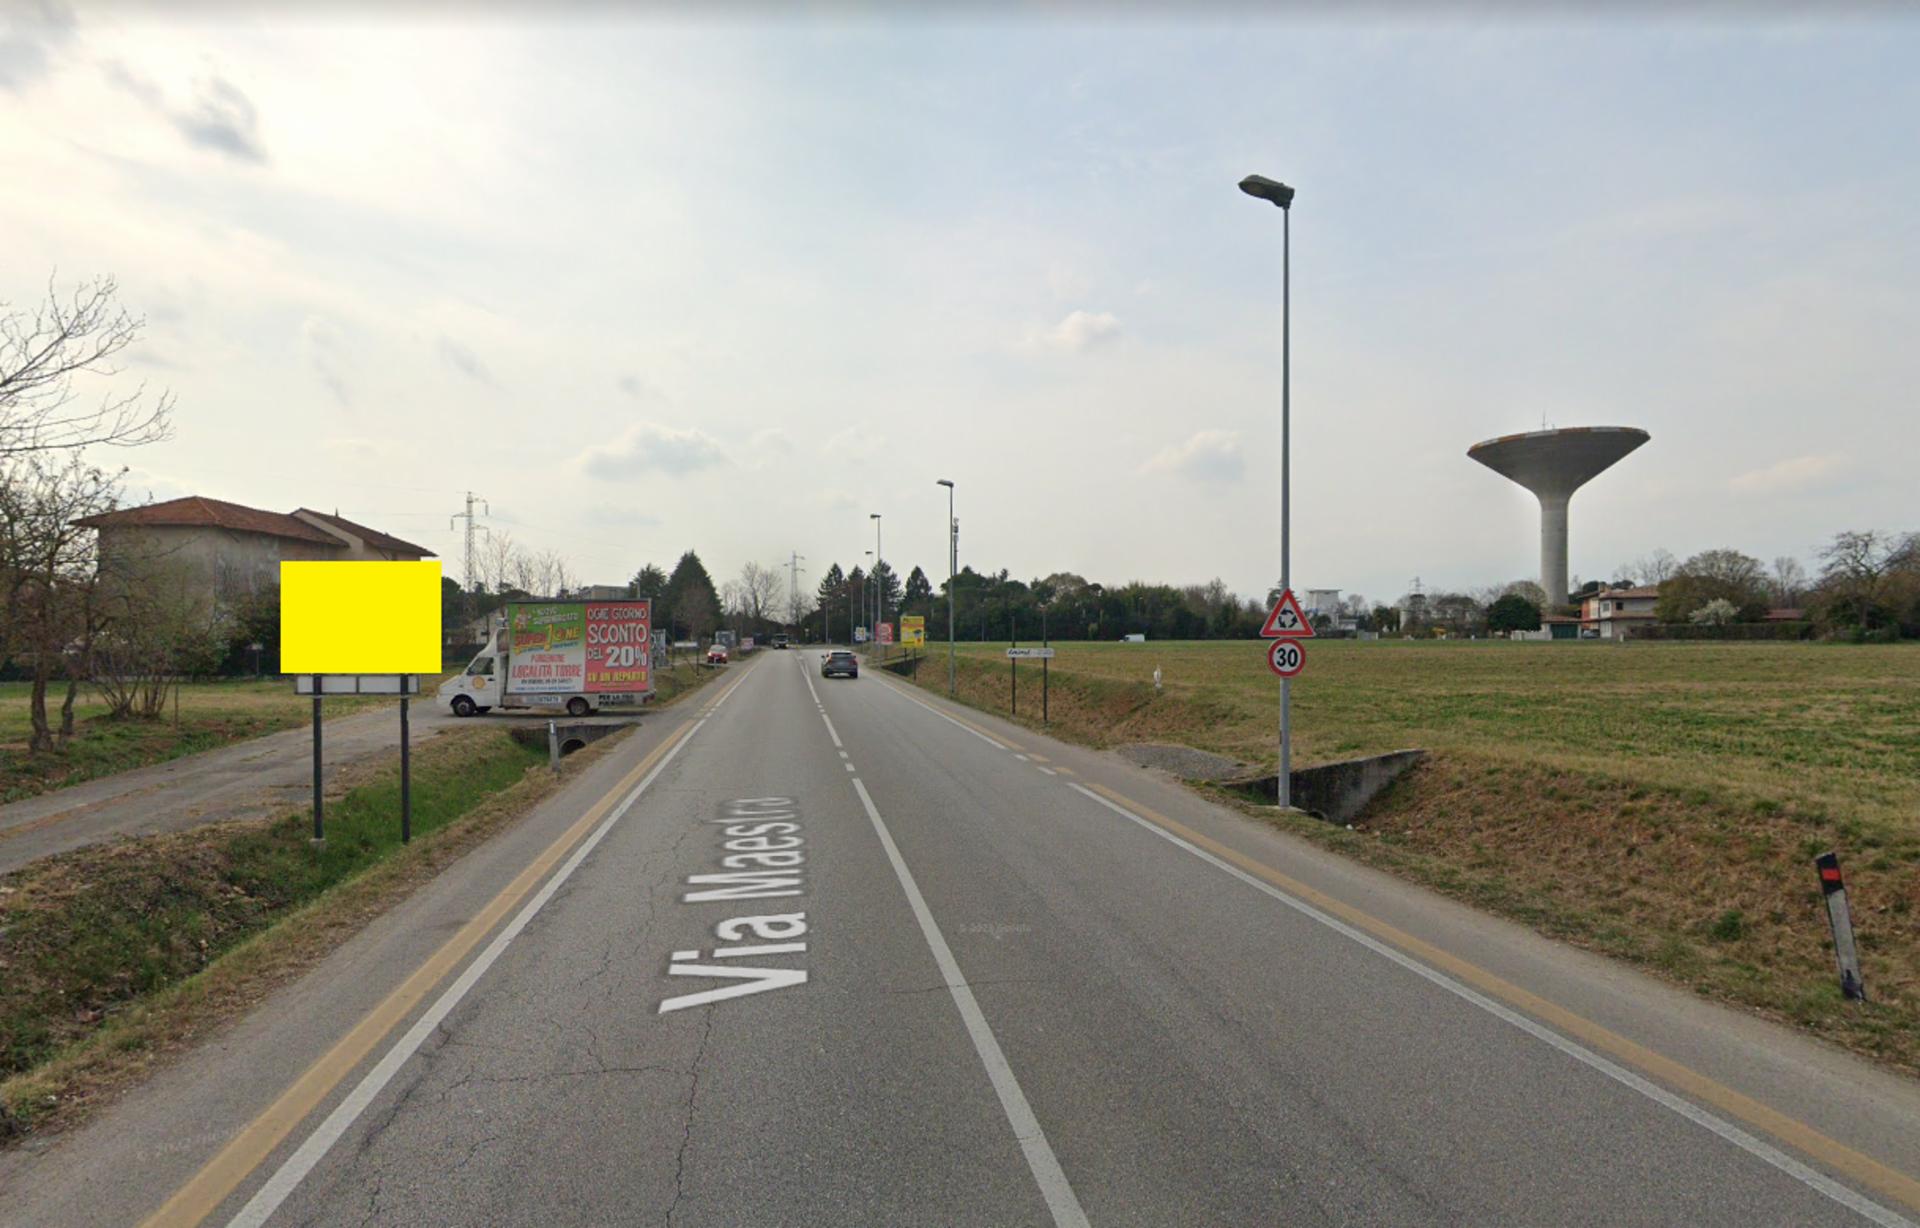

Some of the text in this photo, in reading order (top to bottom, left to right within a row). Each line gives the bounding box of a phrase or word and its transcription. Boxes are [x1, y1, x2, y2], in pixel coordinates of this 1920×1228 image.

[611, 607, 647, 620] GIORNO
[588, 623, 647, 644] SCONTO
[587, 647, 603, 660] DEL
[605, 645, 647, 668] 20%
[1276, 647, 1298, 667] 30
